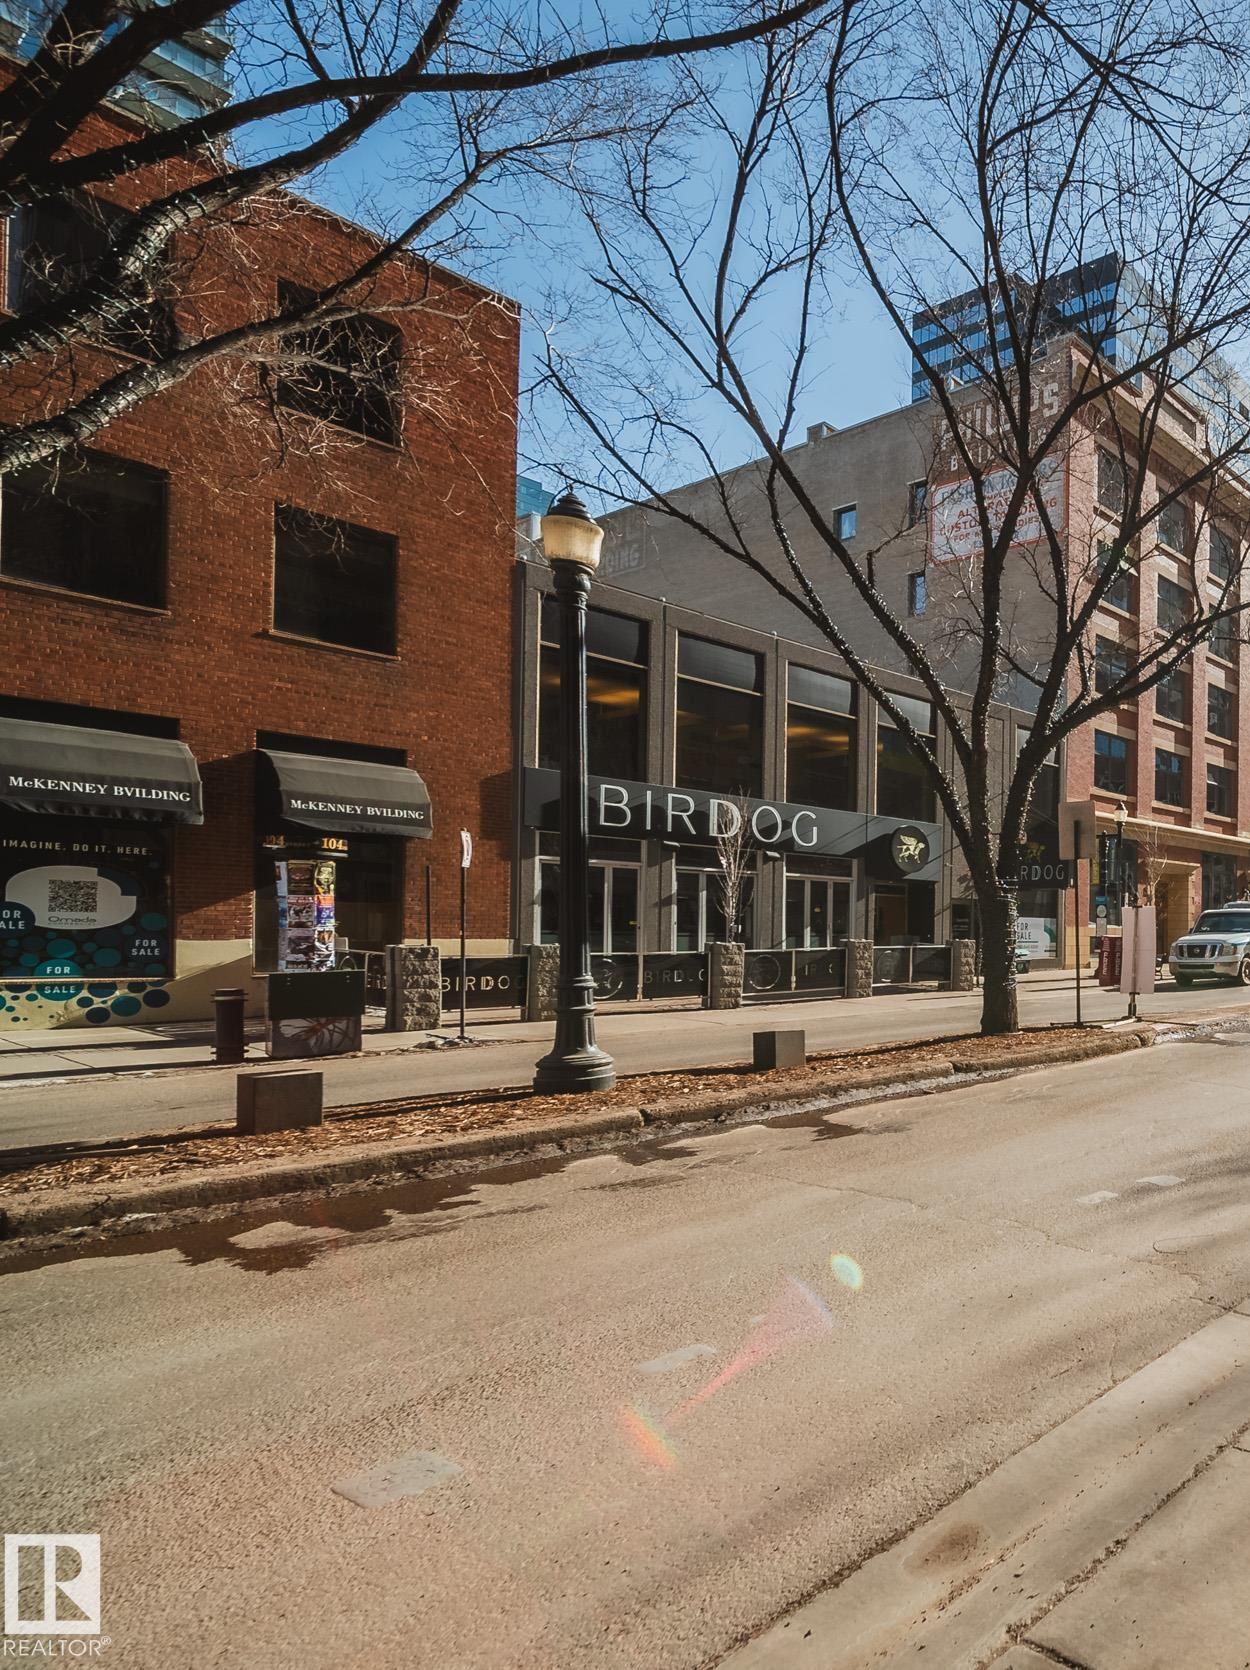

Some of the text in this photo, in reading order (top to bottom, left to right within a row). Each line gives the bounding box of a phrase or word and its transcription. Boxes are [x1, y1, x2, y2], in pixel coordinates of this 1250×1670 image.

[8, 776, 192, 802] McKENNEY BVILDING
[290, 799, 425, 820] McKENNEY BVILDING
[599, 784, 818, 847] BIRDOG
[3, 839, 152, 856] IMAGINE. DO IT. HERE.
[1020, 864, 1065, 881] RDOG
[2, 910, 21, 920] OR
[0, 920, 26, 930] ALE
[1016, 922, 1029, 932] FOR
[1016, 931, 1032, 941] SALE
[135, 939, 158, 948] FOR
[131, 948, 161, 957] SALE
[46, 966, 71, 975] FOR
[441, 975, 525, 992] BIRDO
[44, 985, 77, 995] SALE
